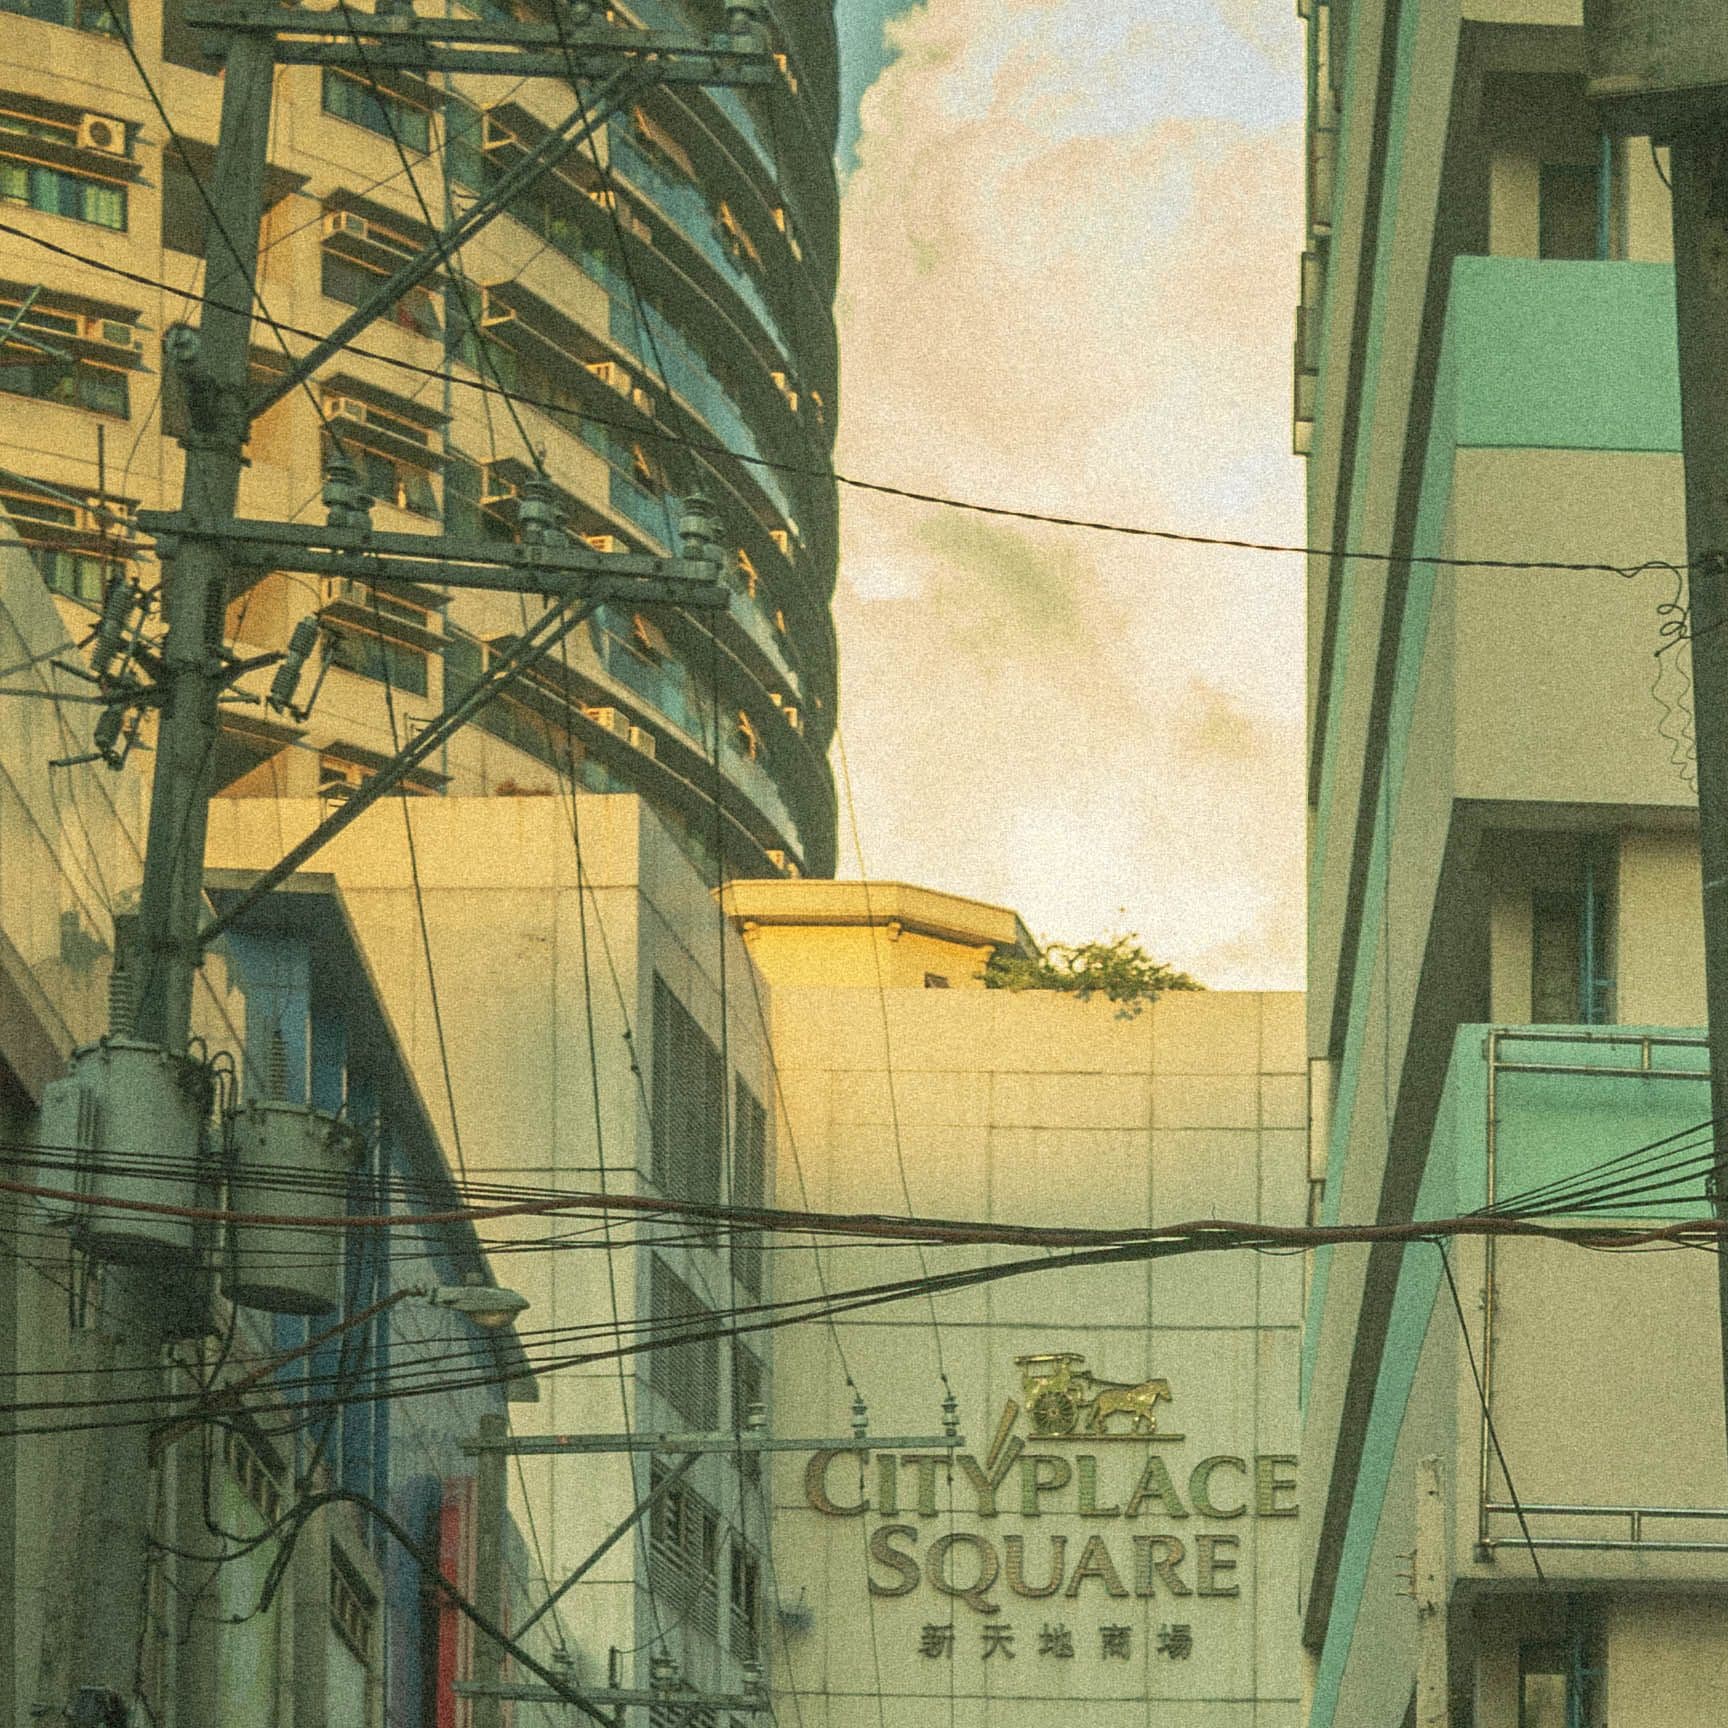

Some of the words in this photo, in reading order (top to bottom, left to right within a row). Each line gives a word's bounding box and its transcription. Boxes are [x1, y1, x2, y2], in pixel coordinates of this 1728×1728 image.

[804, 1400, 1301, 1519] CITYPLACE
[867, 1524, 1241, 1614] SQUARE
[917, 1622, 1196, 1661] 新天地商場
